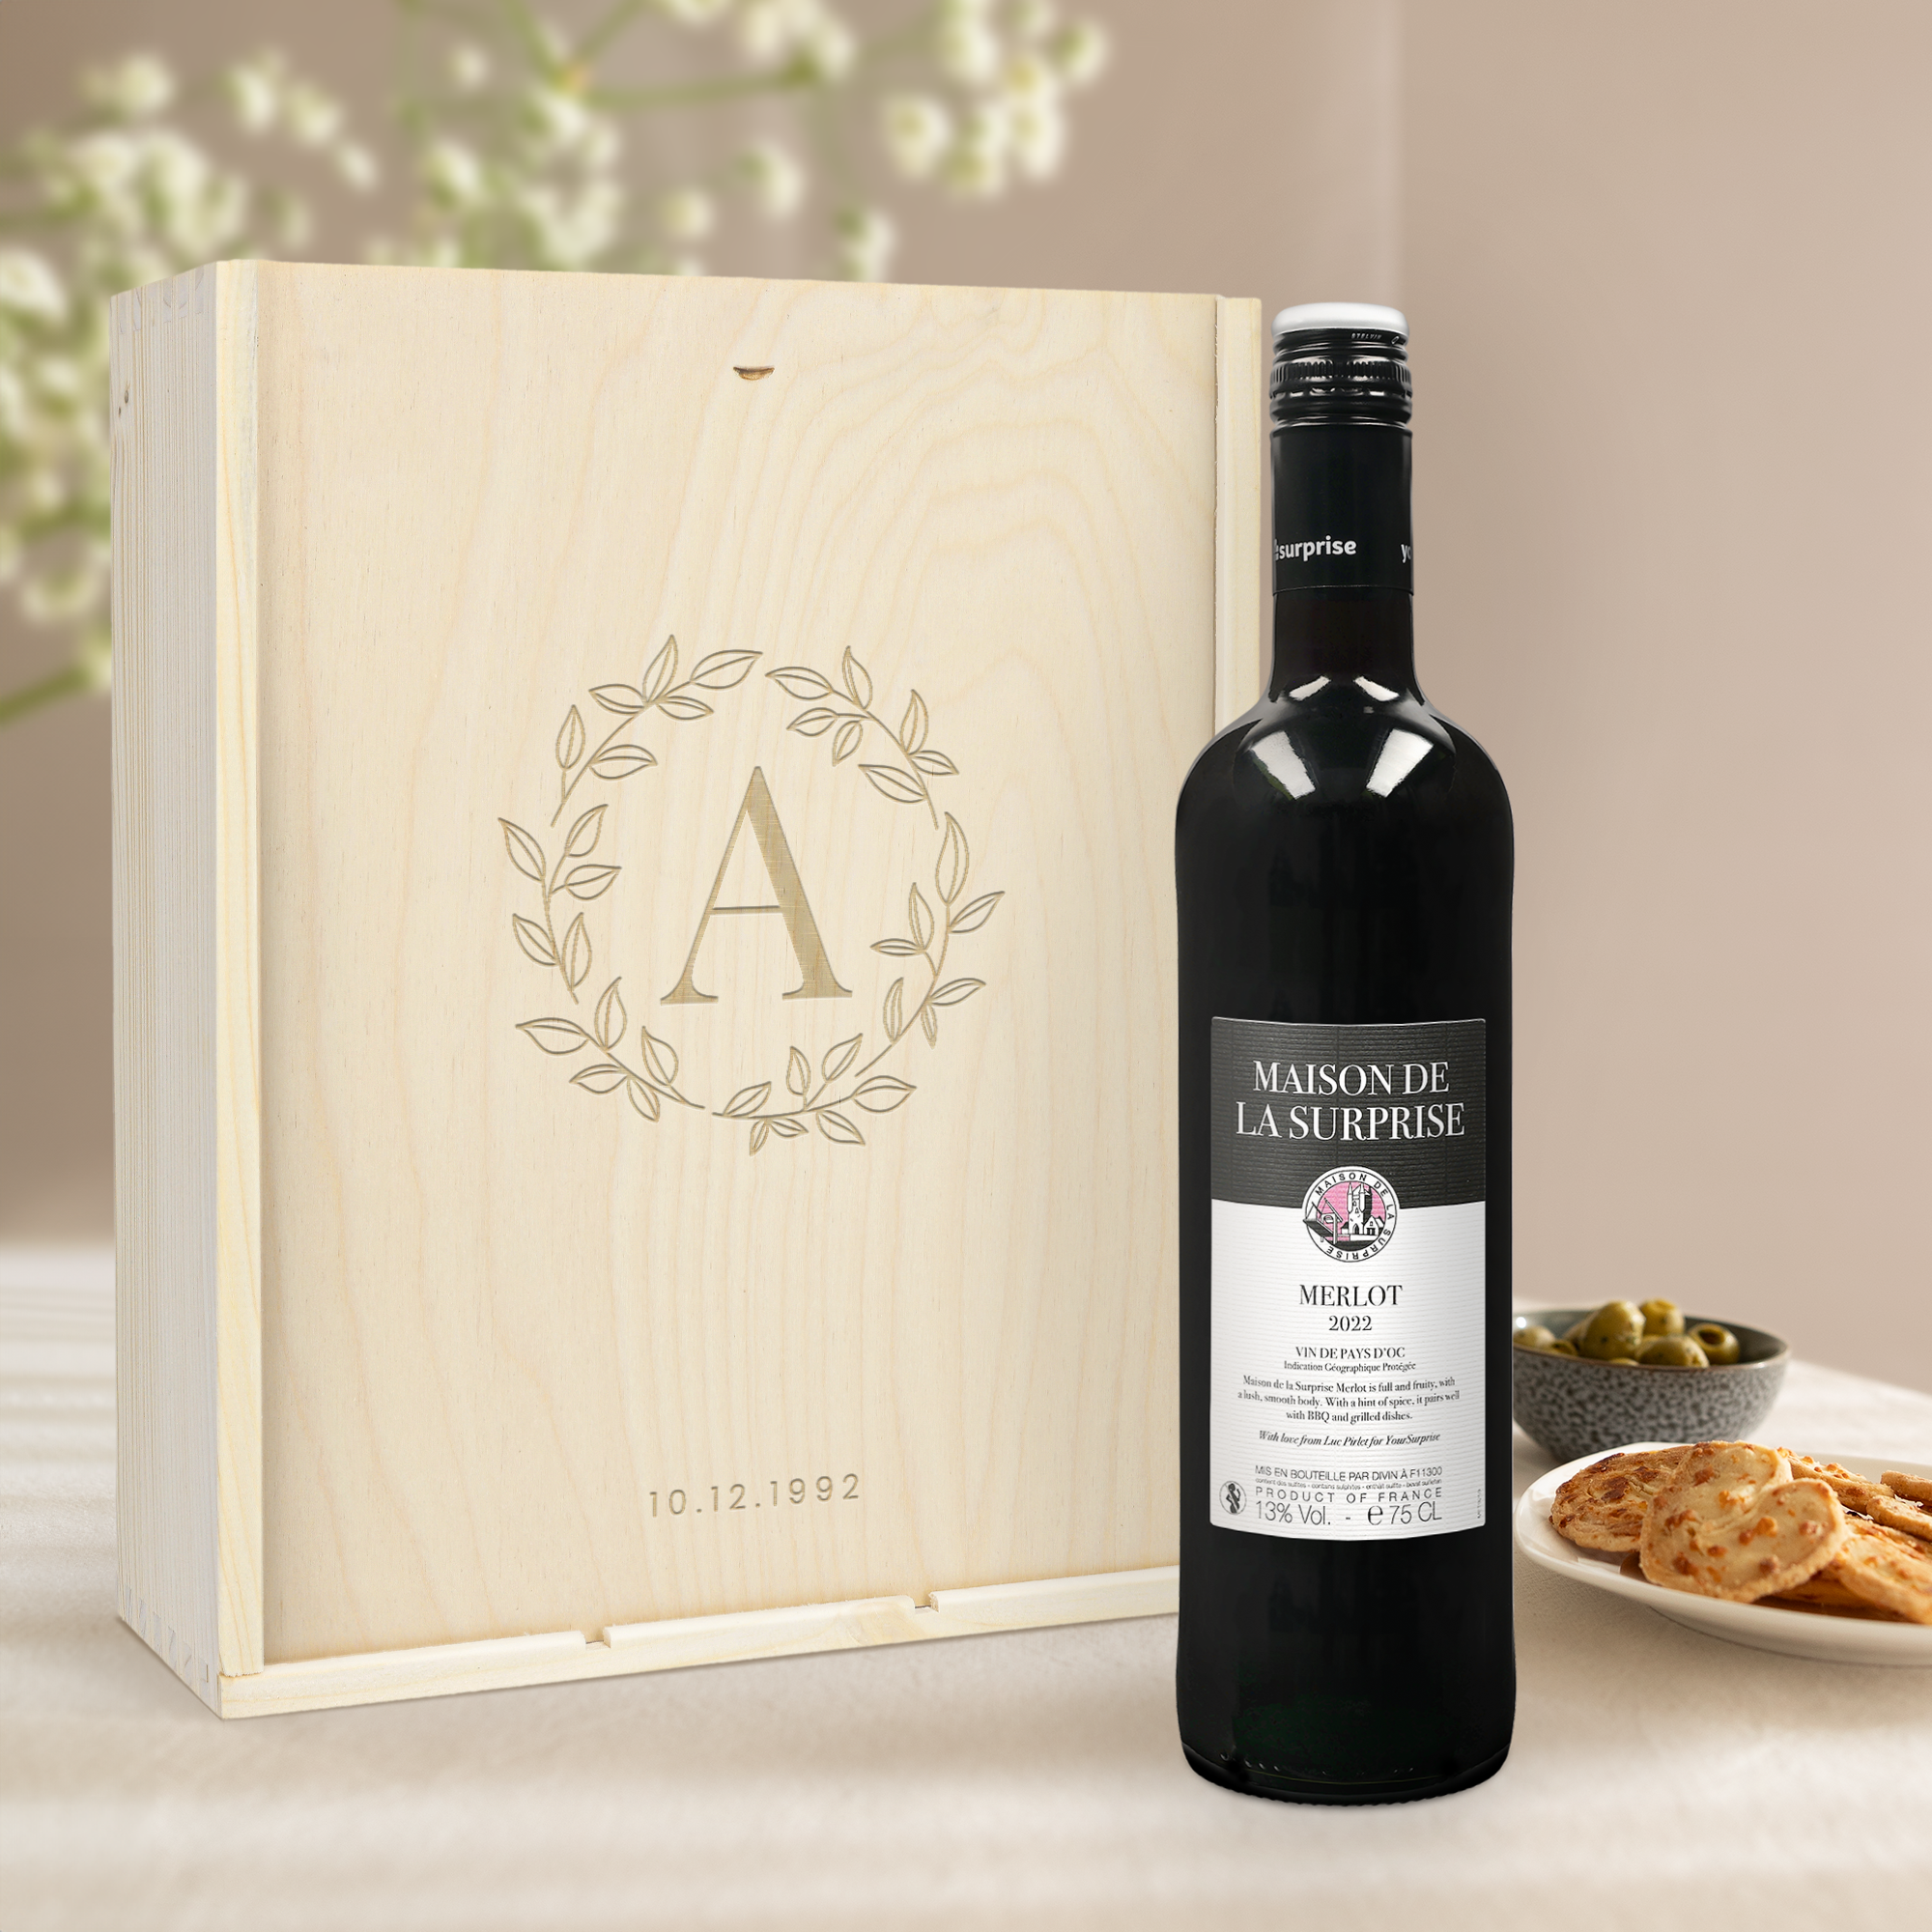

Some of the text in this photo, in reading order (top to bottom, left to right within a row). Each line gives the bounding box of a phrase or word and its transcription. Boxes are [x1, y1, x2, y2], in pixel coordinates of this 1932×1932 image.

[660, 765, 853, 1007] A
[1253, 1060, 1449, 1096] MAISON DE
[1236, 1101, 1465, 1141] LA SURPRISE
[1315, 1172, 1396, 1261] MAISON DE LA SURPRISE
[1299, 1284, 1404, 1307] MERLOT
[1328, 1315, 1373, 1332] 2022
[1295, 1346, 1317, 1358] VIN
[1320, 1348, 1338, 1359] DE
[1341, 1348, 1371, 1359] PAYS
[1284, 1360, 1417, 1375] Indication Géographique Protégée
[1243, 1375, 1271, 1388] Maison
[1273, 1378, 1284, 1389] de
[1286, 1380, 1293, 1390] la
[1295, 1380, 1334, 1394] Surprise
[1336, 1382, 1367, 1393] Merlot
[1369, 1382, 1377, 1393] is
[1378, 1381, 1392, 1392] full
[1394, 1380, 1411, 1391] and
[1439, 1377, 1456, 1387] with
[1264, 1395, 1295, 1405] smooth
[1297, 1395, 1322, 1408] body.
[1325, 1397, 1349, 1407] With
[1357, 1397, 1376, 1406] hint
[1378, 1396, 1388, 1406] of
[1416, 1395, 1422, 1405] it
[1424, 1393, 1444, 1406] pairs
[1445, 1390, 1460, 1401] well
[1286, 1410, 1412, 1425] with BBQ and grilled dishes.
[1259, 1430, 1441, 1449] With love from Luc Pirlet for YourSurprise
[1255, 1464, 1272, 1476] MIS
[1274, 1467, 1288, 1478] EN
[1291, 1469, 1346, 1481] BOUTEILLE
[1349, 1471, 1369, 1481] PAR
[1409, 1465, 1443, 1478] F11300
[649, 1473, 860, 1518] 10.12.1992
[1256, 1487, 1442, 1504] PRODUCT OF FRANCE
[1256, 1500, 1293, 1523] 13%
[1298, 1504, 1331, 1525] Vol.
[1389, 1504, 1412, 1524] 75
[1418, 1501, 1442, 1522] CL
